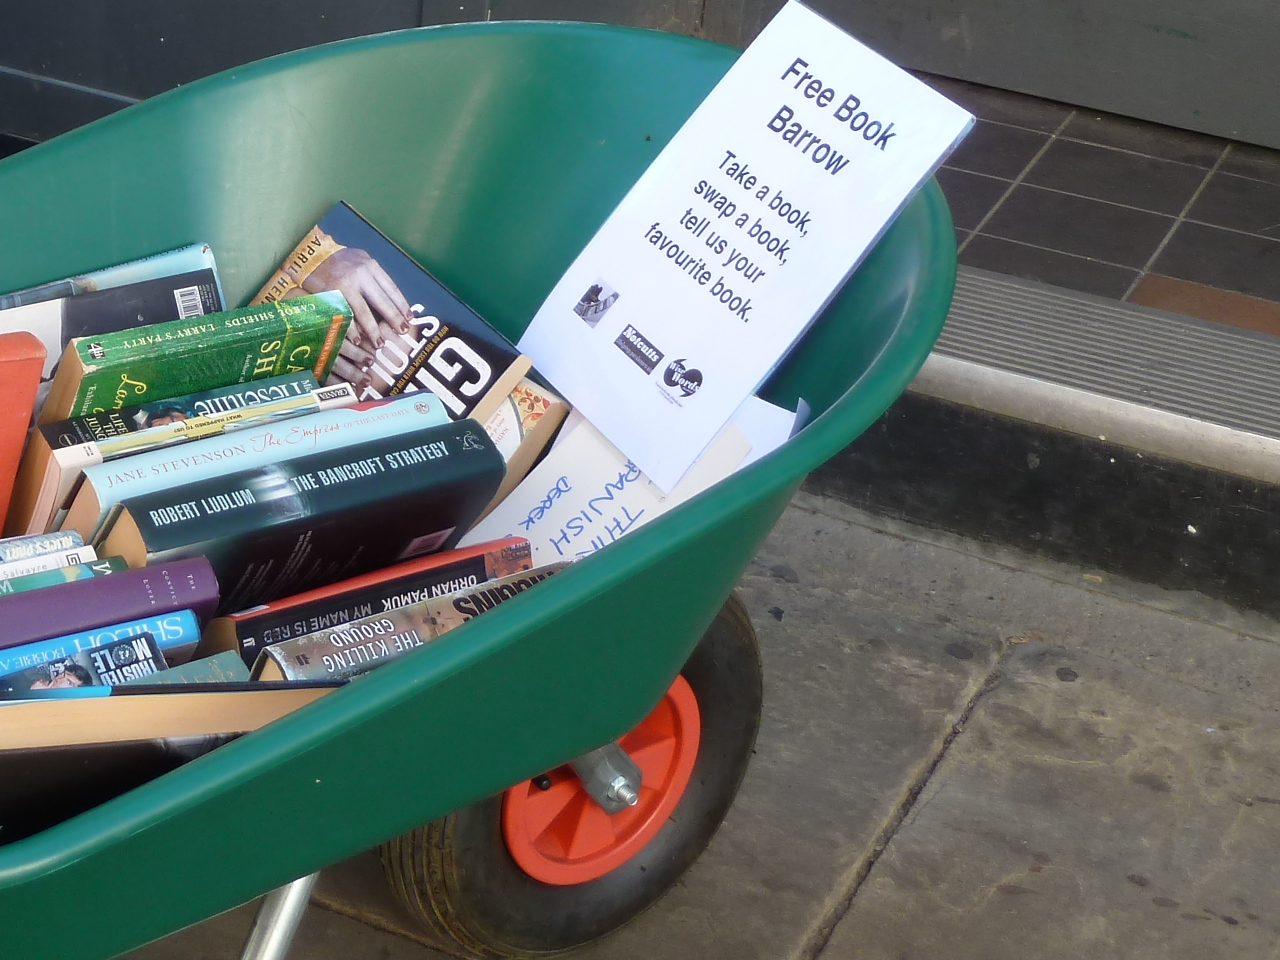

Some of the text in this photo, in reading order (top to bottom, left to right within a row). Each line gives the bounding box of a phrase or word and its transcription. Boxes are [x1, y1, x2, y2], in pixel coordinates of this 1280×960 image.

[780, 57, 898, 152] Free Book
[766, 104, 850, 176] Barrow
[718, 150, 813, 237] Take a book,
[692, 177, 790, 266] swap a book,
[287, 234, 322, 280] APRIL
[679, 206, 767, 286] tell us your
[644, 221, 752, 323] favourite book.
[261, 278, 289, 304] HEN
[121, 301, 316, 349] CAROL SHIELDS LARRY'S PARTY
[436, 324, 449, 339] HOW
[359, 303, 441, 402] STOLE
[424, 341, 435, 353] YOU
[431, 335, 441, 344] DO
[622, 326, 660, 362] Notcutts
[411, 349, 428, 368] ESCAPE
[669, 361, 686, 374] Wise
[395, 376, 406, 389] YOU
[402, 364, 416, 380] WHEN
[405, 336, 492, 416] GI
[672, 372, 701, 391] Words
[319, 387, 349, 402] GRANTA
[86, 417, 108, 441] JUNG
[109, 413, 129, 434] LIFE
[193, 416, 225, 428] HAPPENED
[225, 412, 242, 421] WHAT
[104, 427, 119, 442] TH
[106, 408, 410, 488] JANE STEVENSON The Empress OF THE LAST DAYS
[148, 439, 451, 528] ROBERT LUDLUM THE BANCROFT STRATEGY
[516, 476, 573, 530] DEREK
[4, 535, 74, 561] ALICE'S PART
[2, 563, 48, 580] Salvayre
[186, 573, 196, 590] THE
[142, 578, 155, 605] LOVER
[161, 569, 178, 607] CONVICT
[263, 573, 477, 644] ORHAN PAMUK MY NAME IS RED
[327, 616, 395, 648] GROUND
[12, 646, 66, 668] BOBBIE
[320, 627, 423, 673] THE KILLING
[99, 664, 154, 686] TRUSTED
